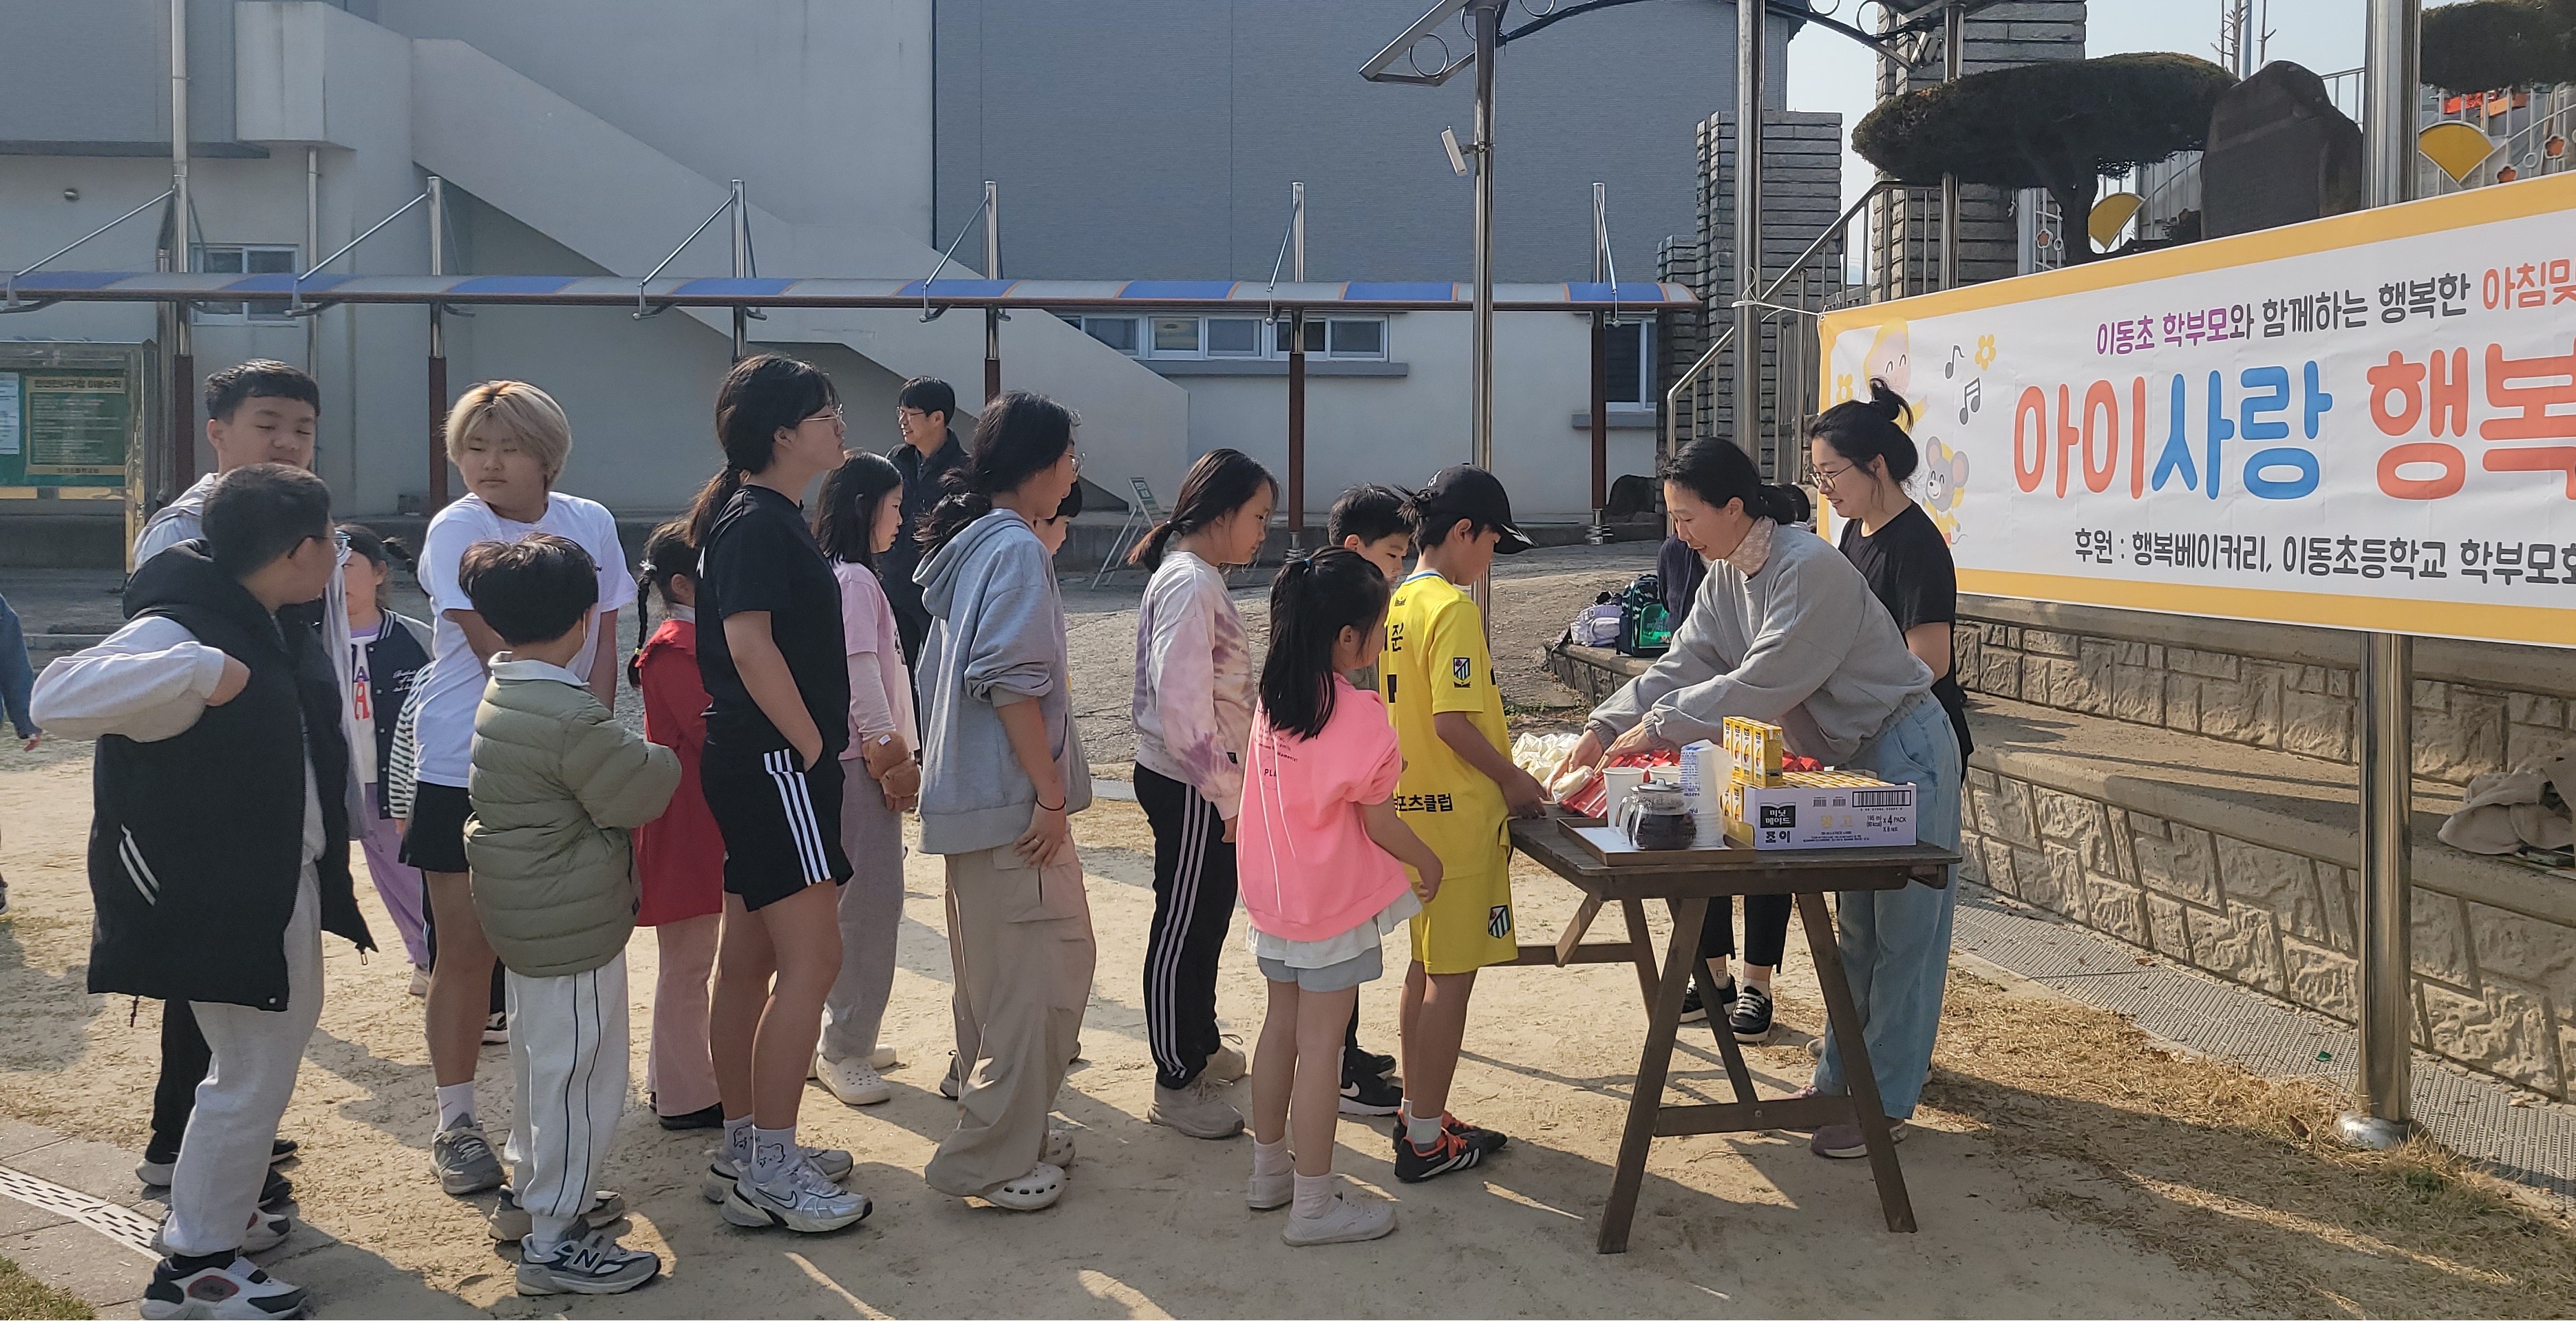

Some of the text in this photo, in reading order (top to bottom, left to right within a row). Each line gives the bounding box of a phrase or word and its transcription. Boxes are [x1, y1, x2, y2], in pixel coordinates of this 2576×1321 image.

[2096, 315, 2155, 356] 이동초
[2162, 302, 2255, 348] 학부모와
[2262, 289, 2368, 339] 함께하는
[2378, 273, 2471, 324] 행복한
[2013, 337, 2576, 500] 아이사랑 행복
[2075, 528, 2113, 564] 후원
[2132, 531, 2272, 573] 행복베이커리,
[2283, 534, 2447, 580] 이동초등학교
[1765, 817, 1791, 825] 메이드
[1769, 809, 1787, 818] 미닛
[1887, 814, 1893, 825] 4
[1765, 830, 1791, 843] 조이
[573, 1248, 602, 1269] N
